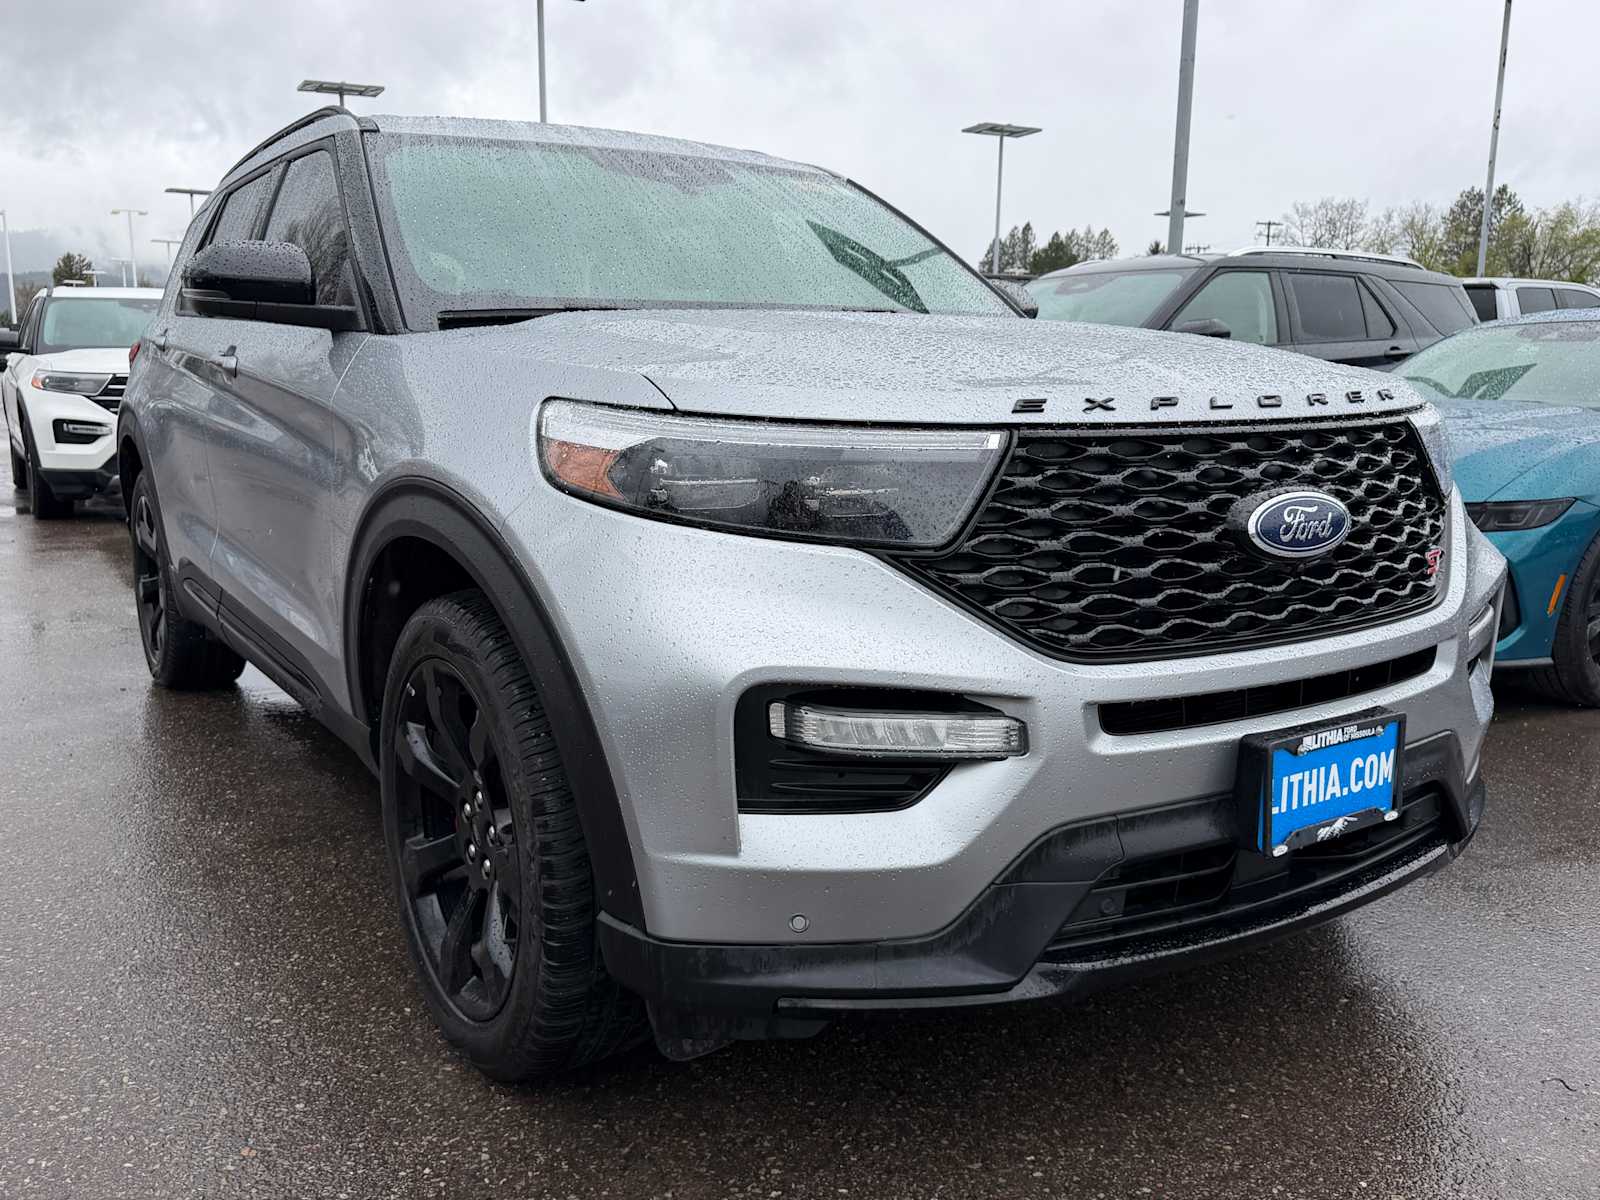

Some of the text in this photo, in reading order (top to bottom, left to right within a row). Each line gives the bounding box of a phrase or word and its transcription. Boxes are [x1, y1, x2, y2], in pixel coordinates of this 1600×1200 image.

[1011, 388, 1395, 413] EXPLORER
[1279, 505, 1334, 542] Ford
[1312, 728, 1343, 750] LITHIA
